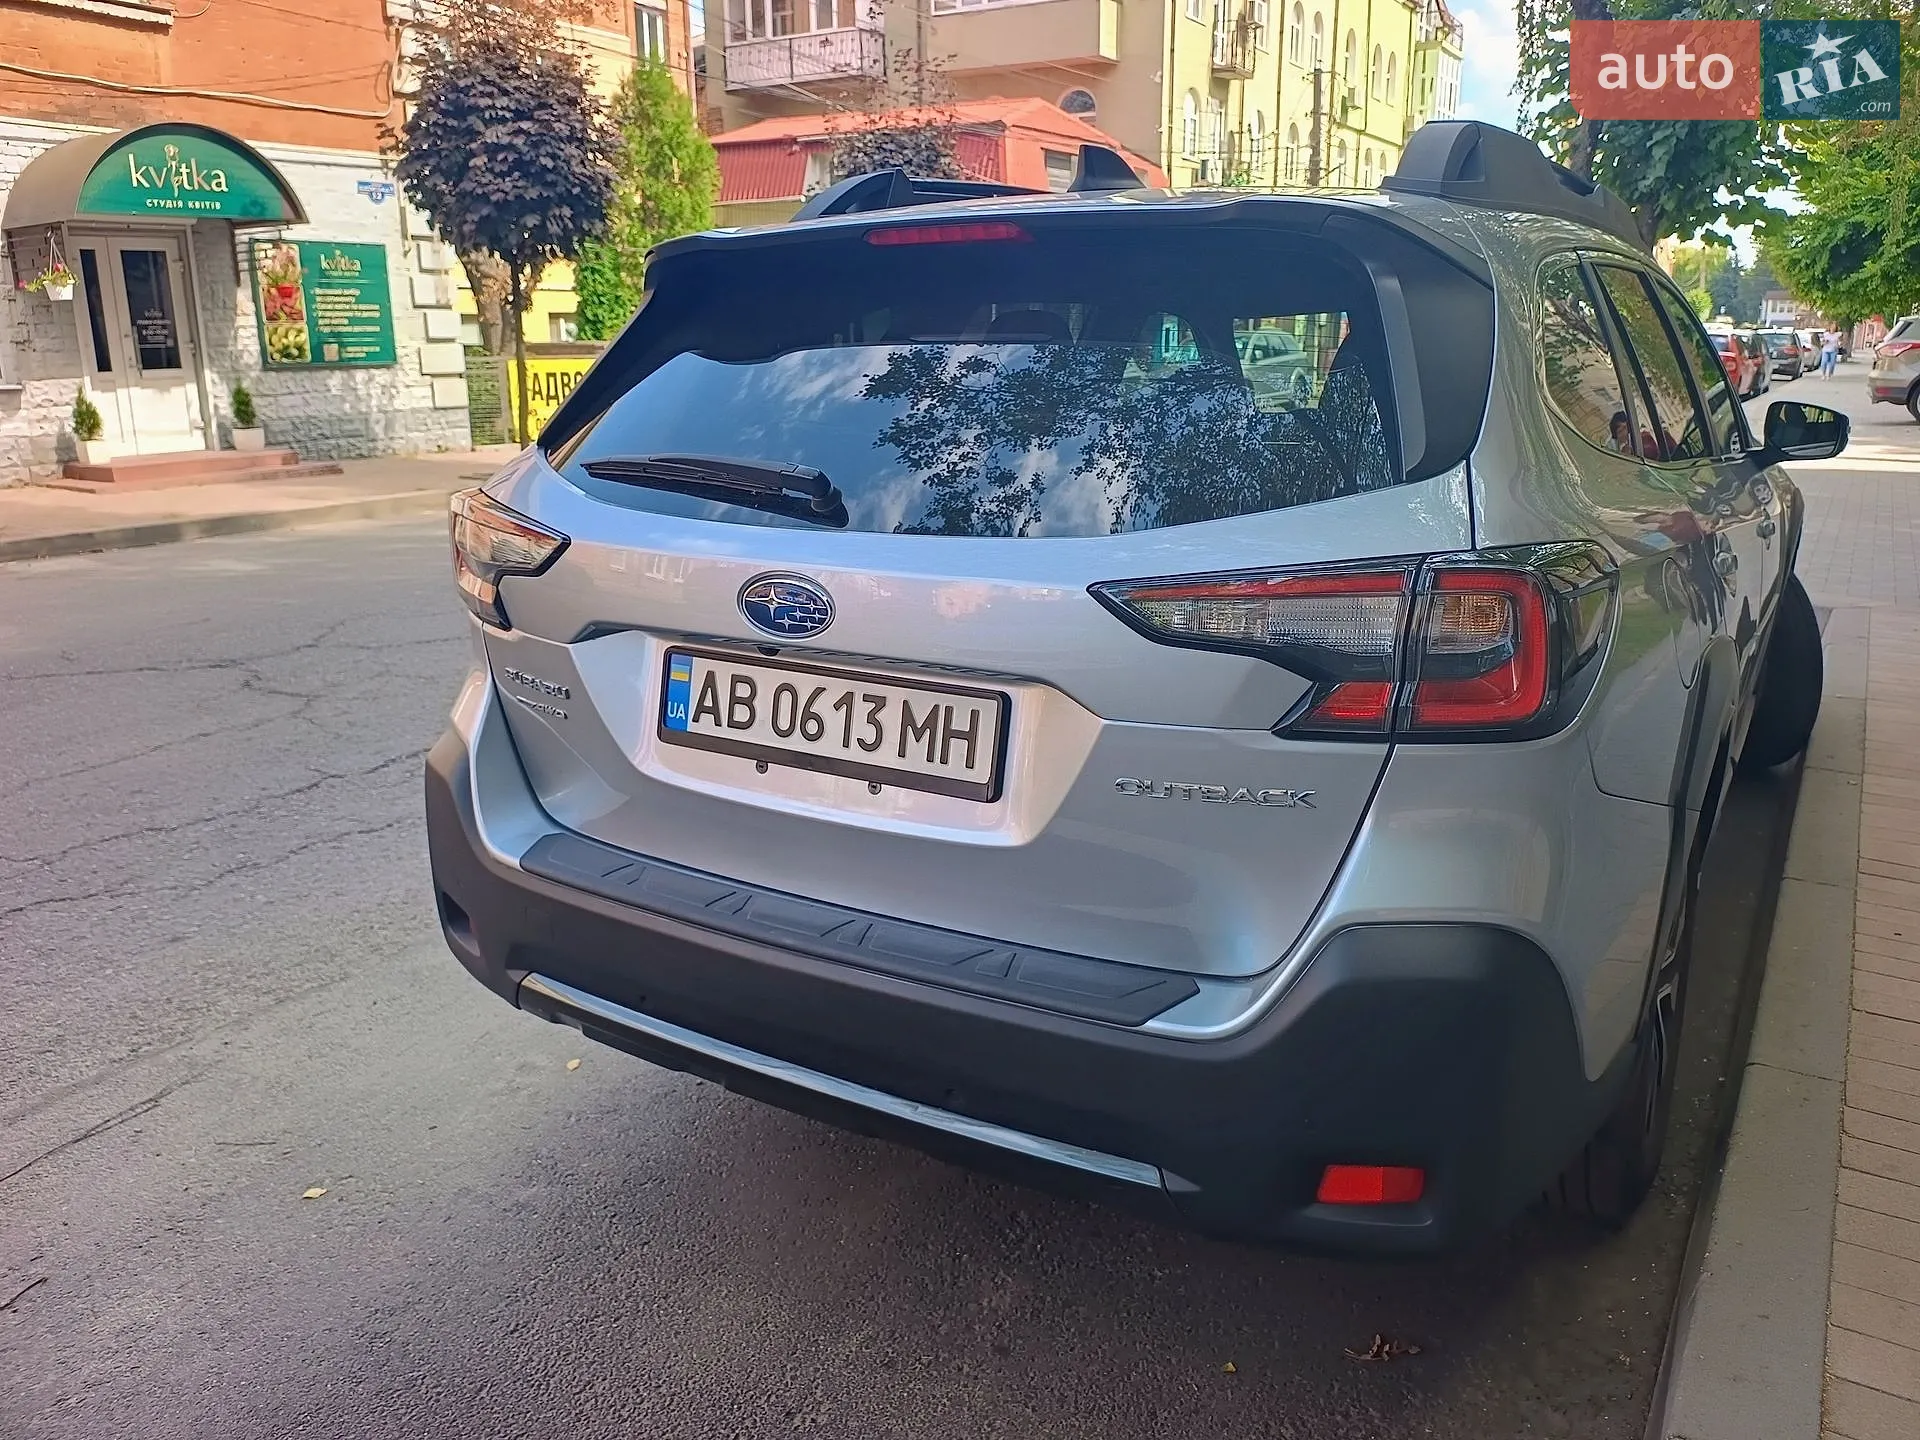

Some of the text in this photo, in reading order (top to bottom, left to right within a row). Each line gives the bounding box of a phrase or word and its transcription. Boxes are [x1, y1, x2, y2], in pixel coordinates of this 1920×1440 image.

[128, 145, 229, 197] kvitka
[146, 199, 183, 209] СТУДІЯ
[667, 700, 686, 720] UA
[692, 670, 980, 769] AB 0613 MH
[1113, 776, 1317, 809] OUTBACK
